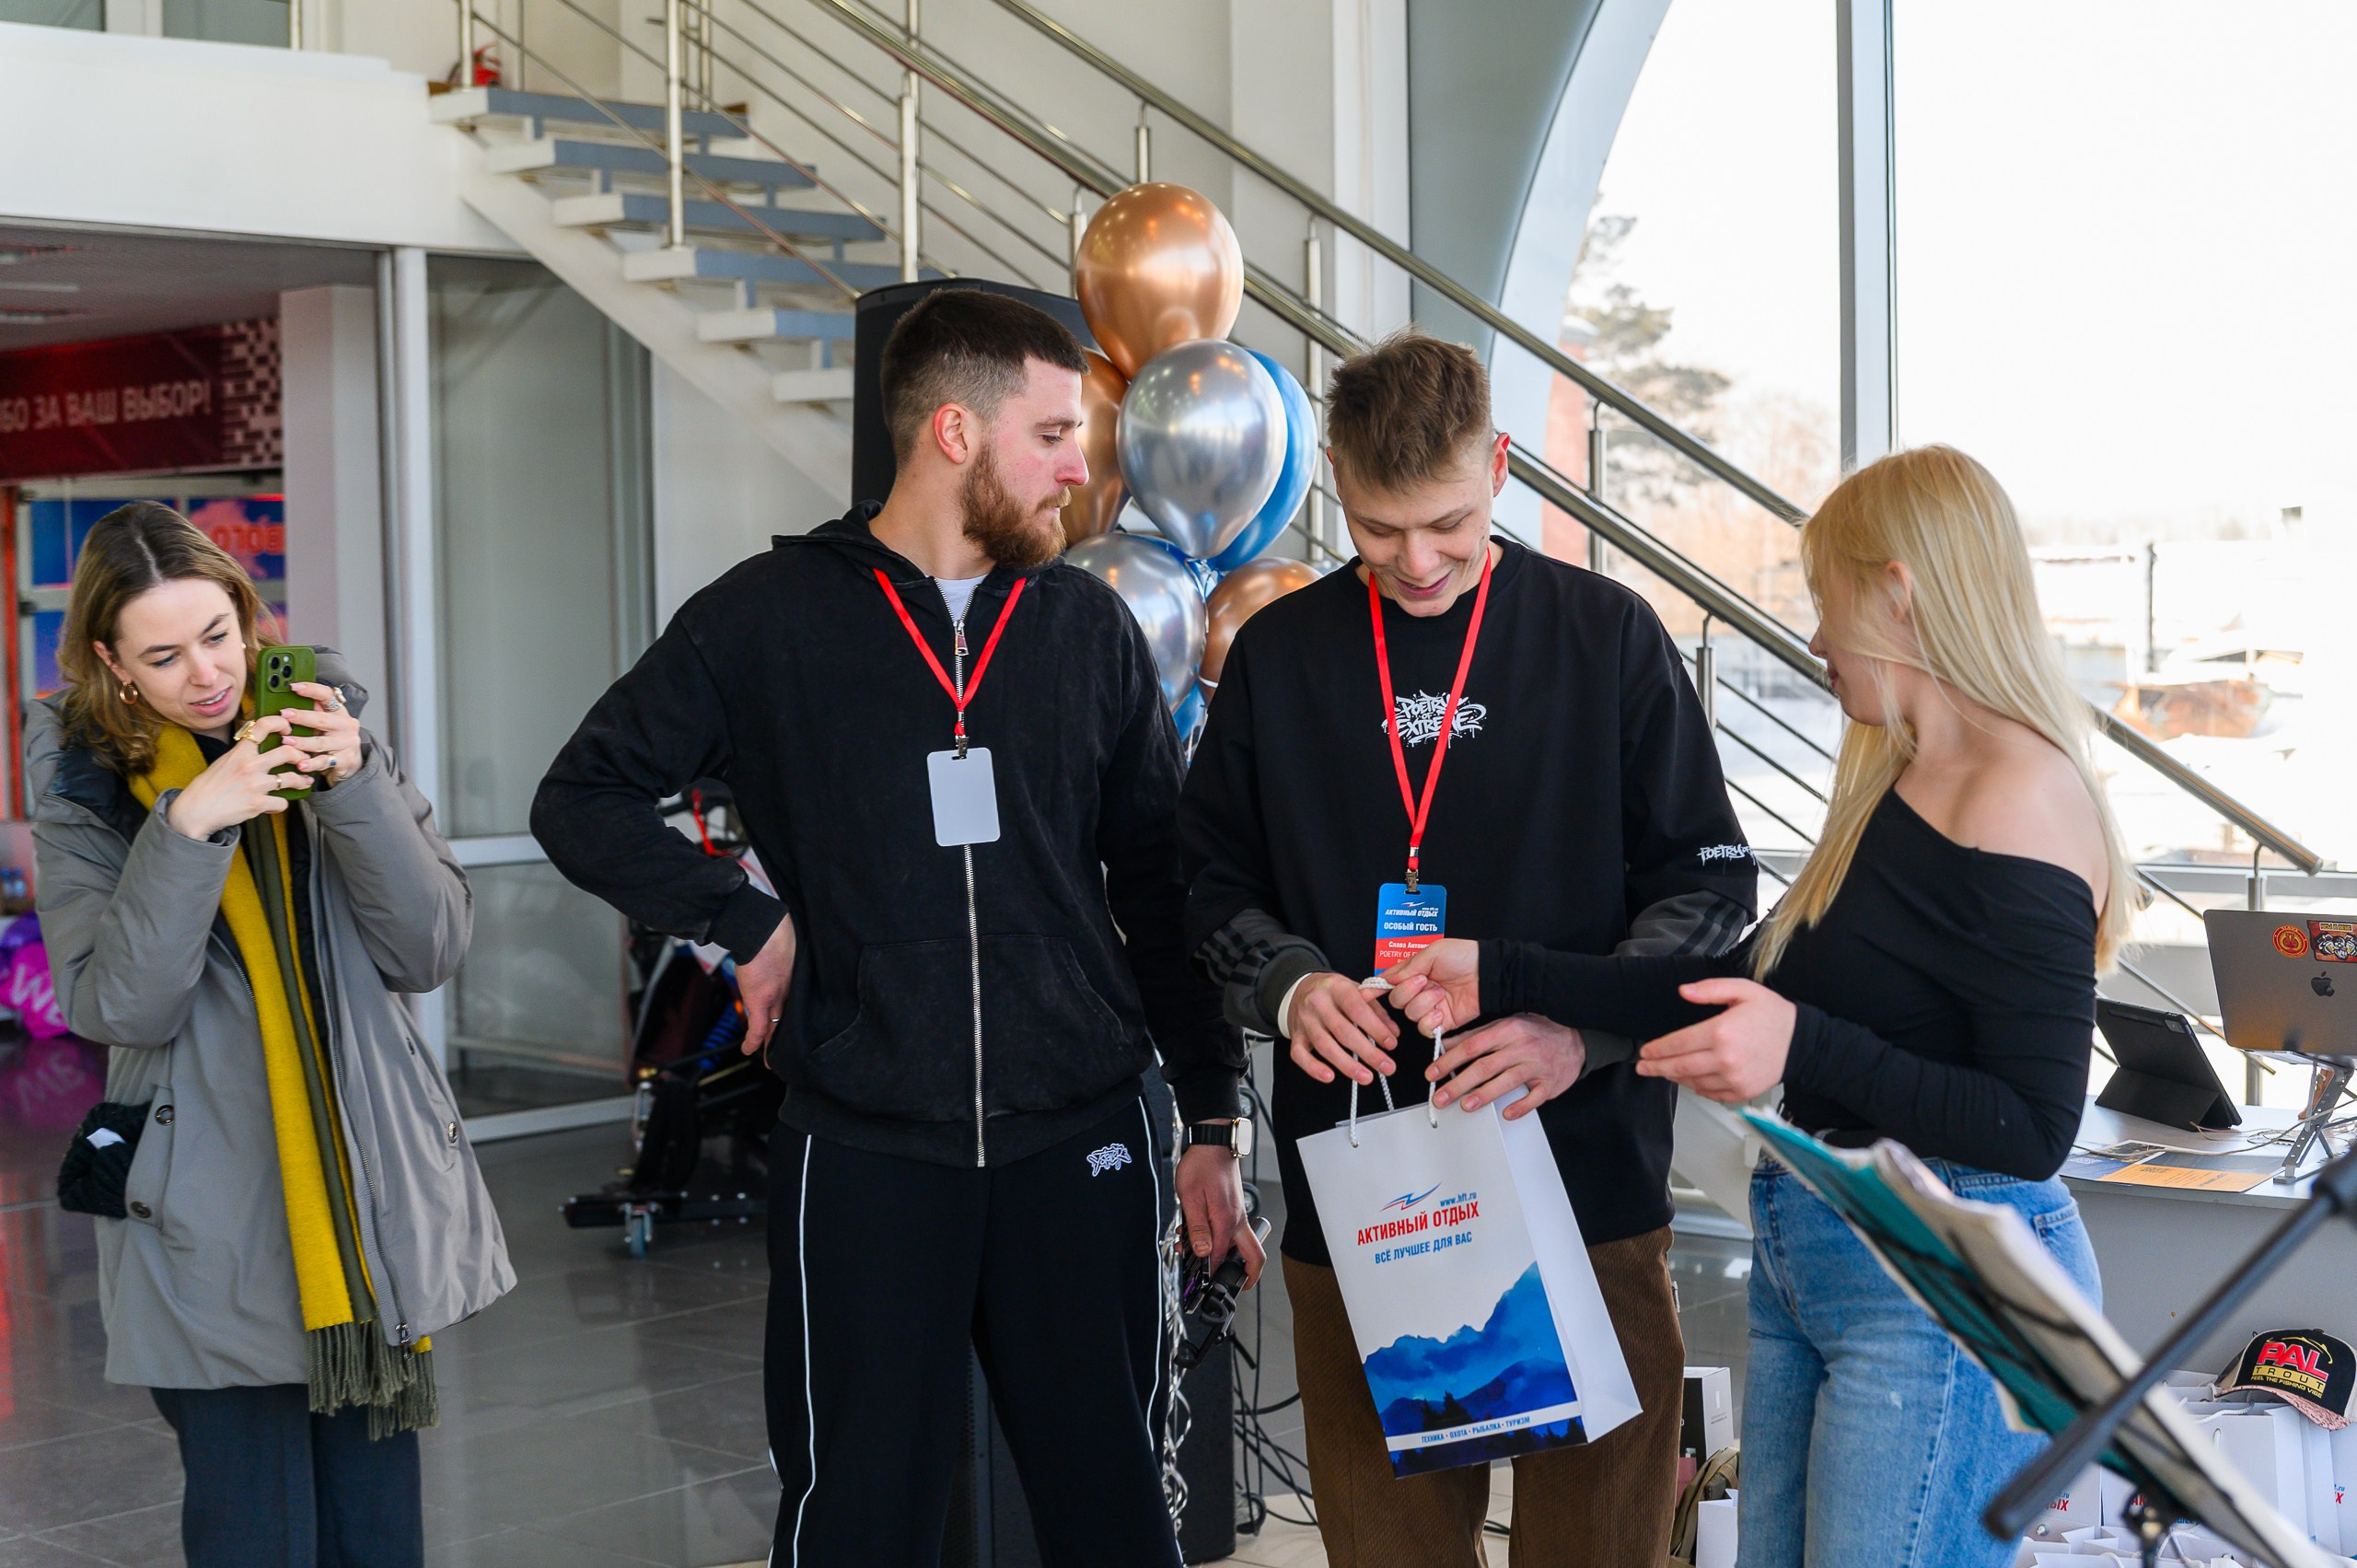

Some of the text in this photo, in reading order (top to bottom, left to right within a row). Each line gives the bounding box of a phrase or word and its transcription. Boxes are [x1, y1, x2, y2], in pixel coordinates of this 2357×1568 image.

[33, 394, 63, 430] ЗА
[66, 389, 118, 426] ВАШ
[122, 379, 213, 423] ВЫБОР!
[1697, 843, 1745, 865] POETRY
[1384, 922, 1437, 932] ОСОБЫЙ ГОСТЬ
[1440, 1192, 1477, 1207] www.hft.ru
[1357, 1201, 1480, 1246] АКТИВНЫЙ ОТДЫХ
[1375, 1231, 1473, 1264] ВСЁ ЛУЧШЕЕ ДЛЯ ВАС
[2256, 1342, 2329, 1382] PAL
[2256, 1366, 2324, 1390] TROUT
[2279, 1379, 2306, 1391] FISHING
[2307, 1388, 2323, 1399] VIBE
[1422, 1416, 1530, 1443] ТЕХНИКА ОХОТА РЫБАЛКА ТУРИЗМ
